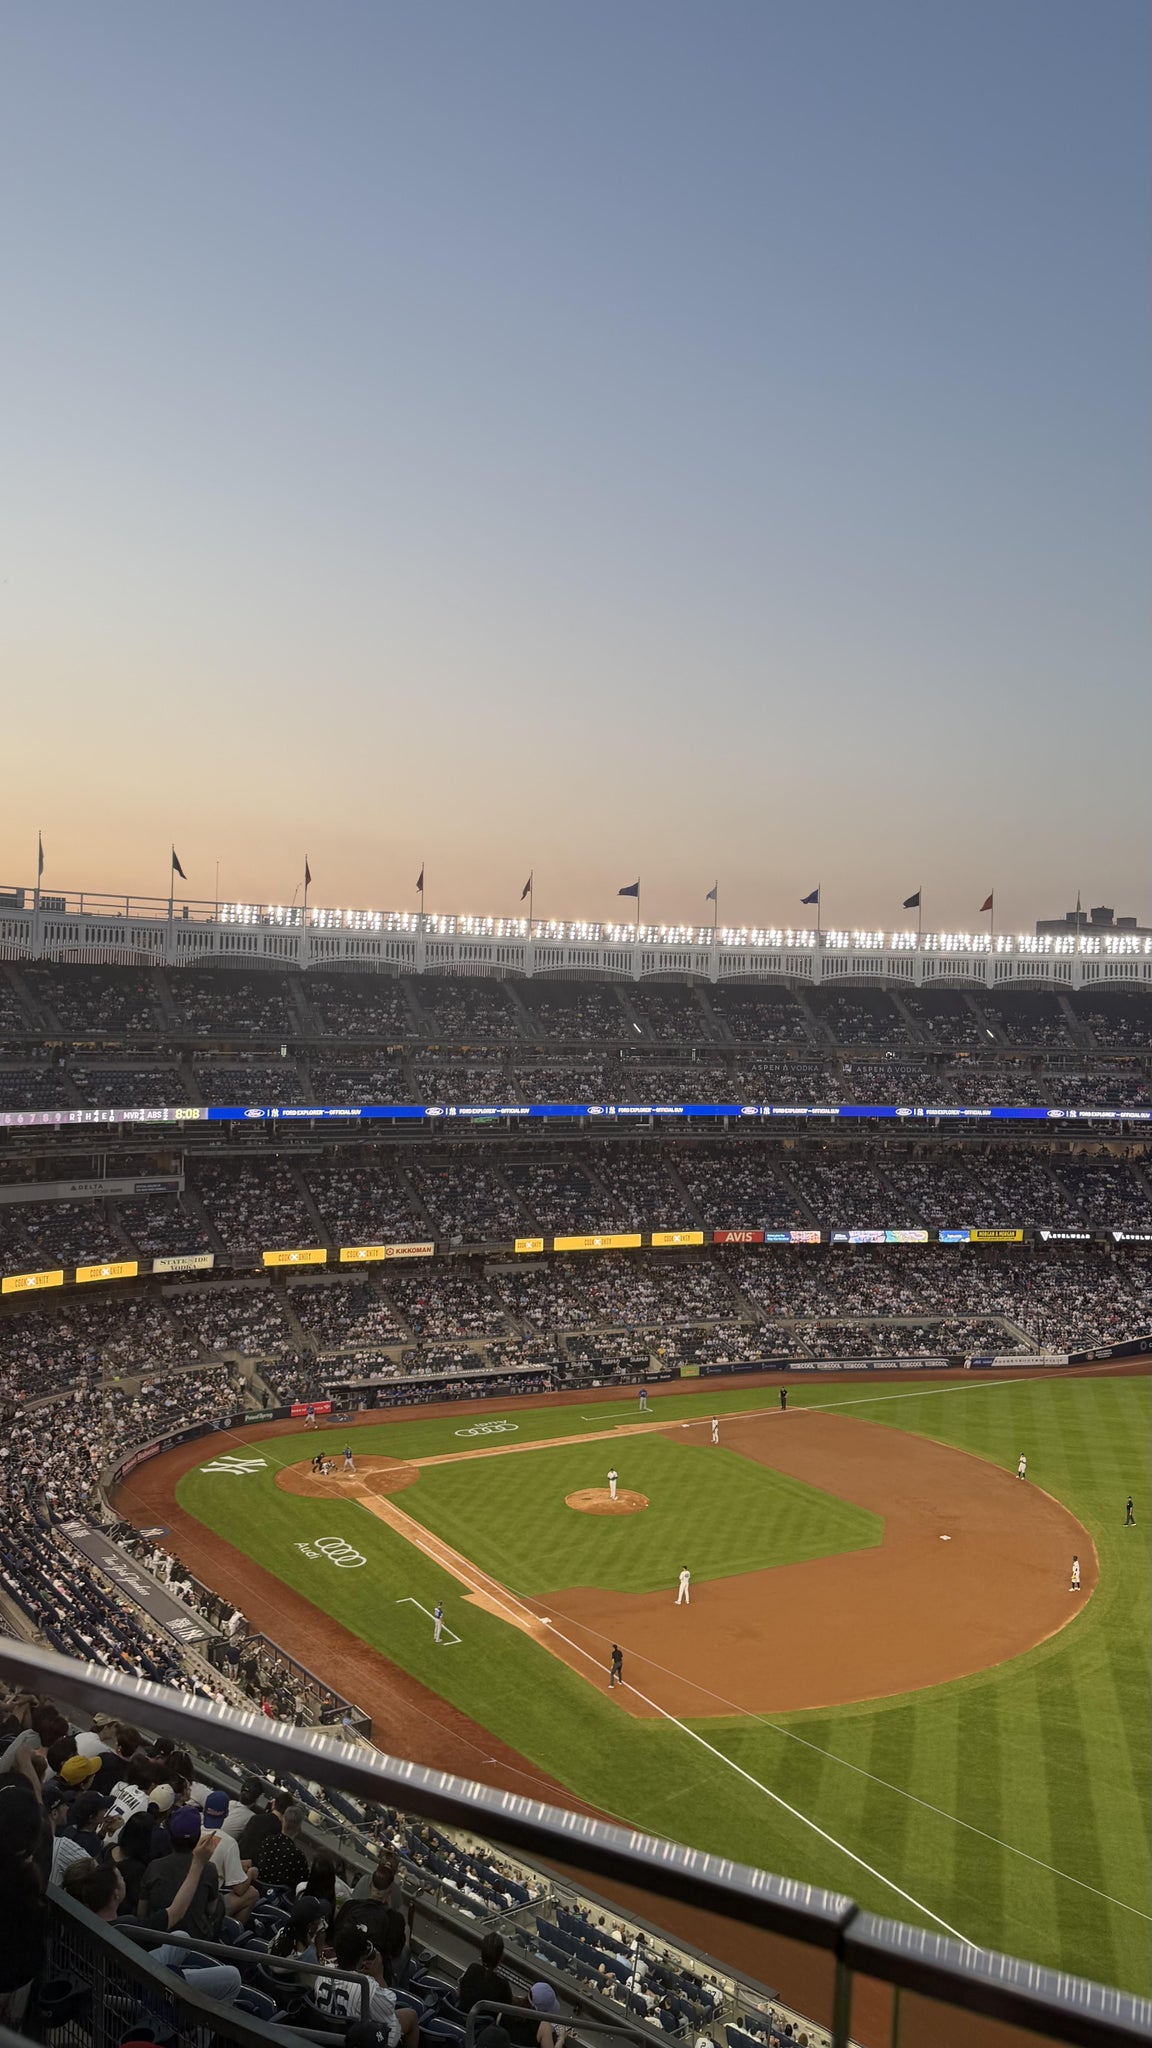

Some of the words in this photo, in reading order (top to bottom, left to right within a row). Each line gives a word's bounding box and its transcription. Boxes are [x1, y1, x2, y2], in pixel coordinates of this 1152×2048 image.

[30, 1114, 36, 1122] 7
[55, 1113, 61, 1121] 9
[175, 1109, 200, 1119] 8:08
[725, 1232, 752, 1241] AVIS
[293, 1542, 322, 1559] Audi
